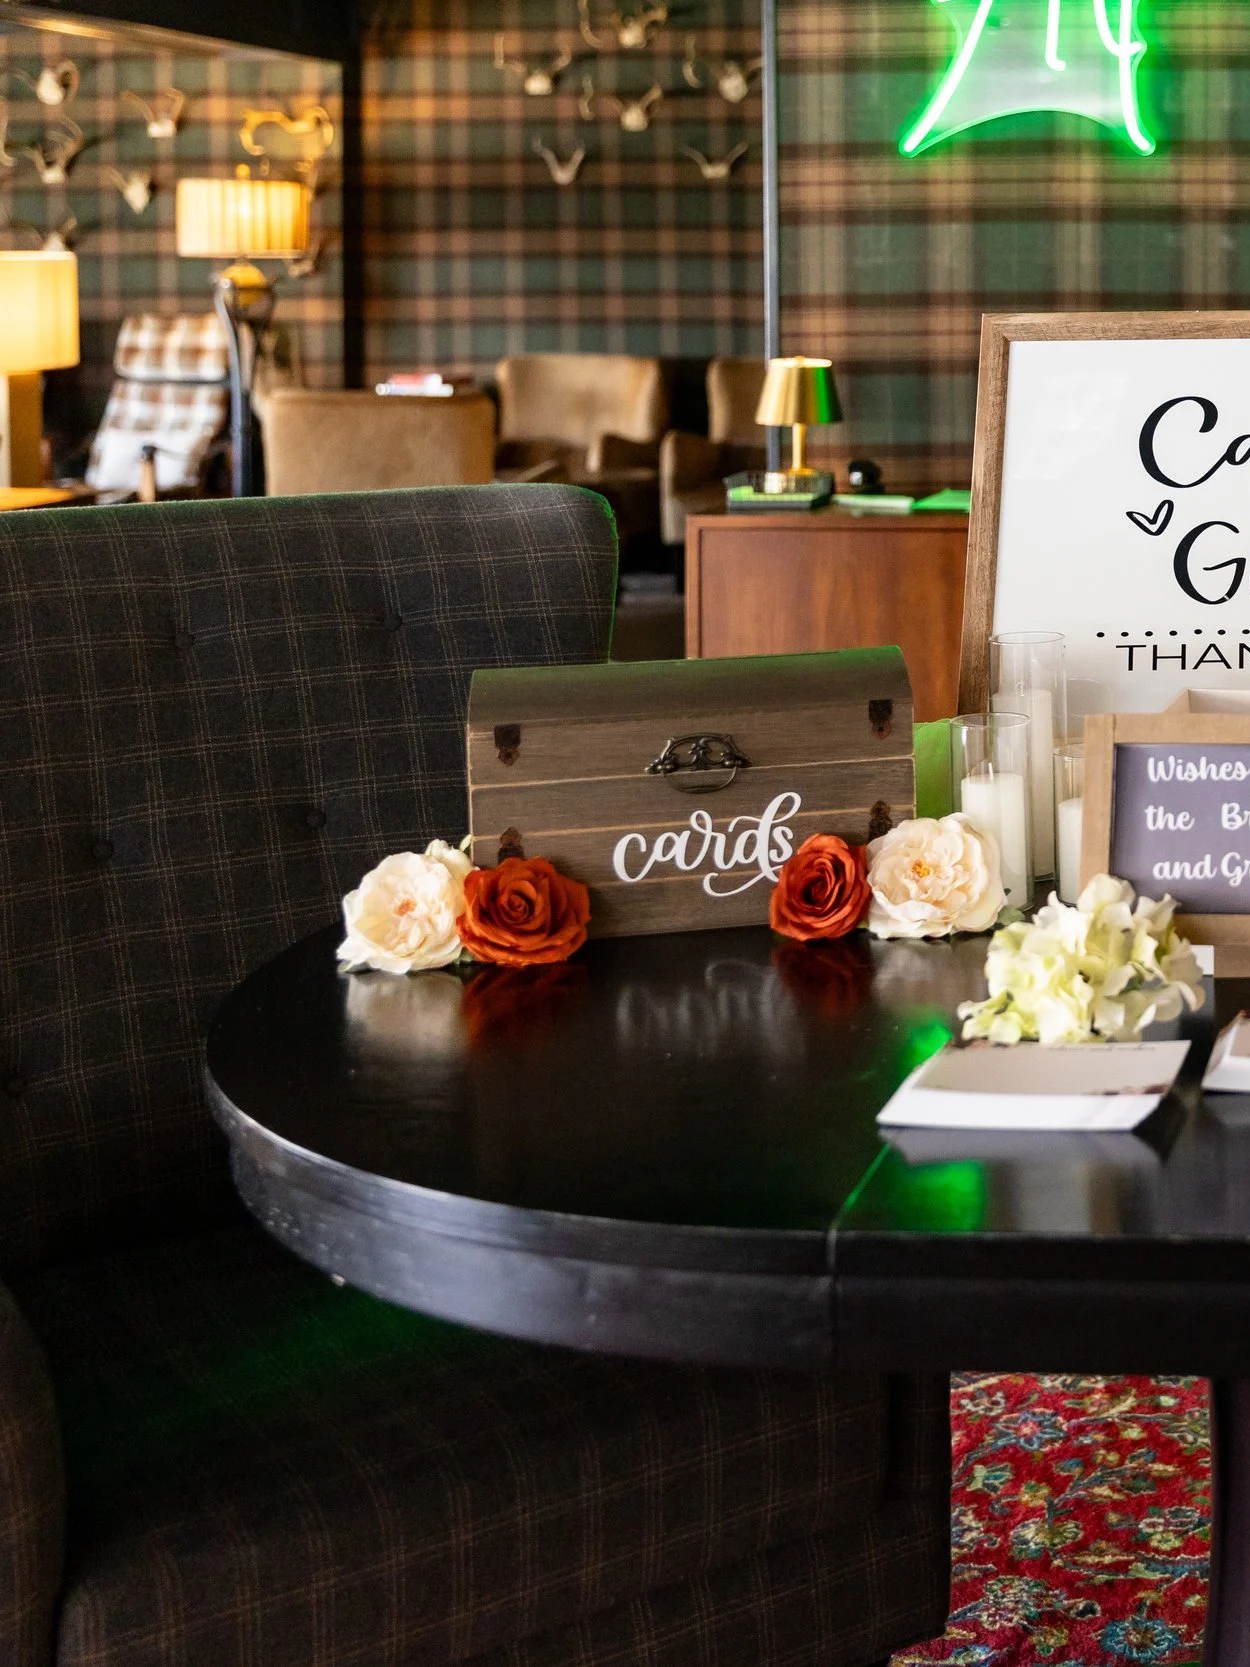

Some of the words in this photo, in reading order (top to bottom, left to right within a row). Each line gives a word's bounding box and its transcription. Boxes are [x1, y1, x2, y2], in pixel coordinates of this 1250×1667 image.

[1144, 802, 1195, 831] the
[612, 791, 802, 898] cards
[1151, 852, 1218, 881] and
